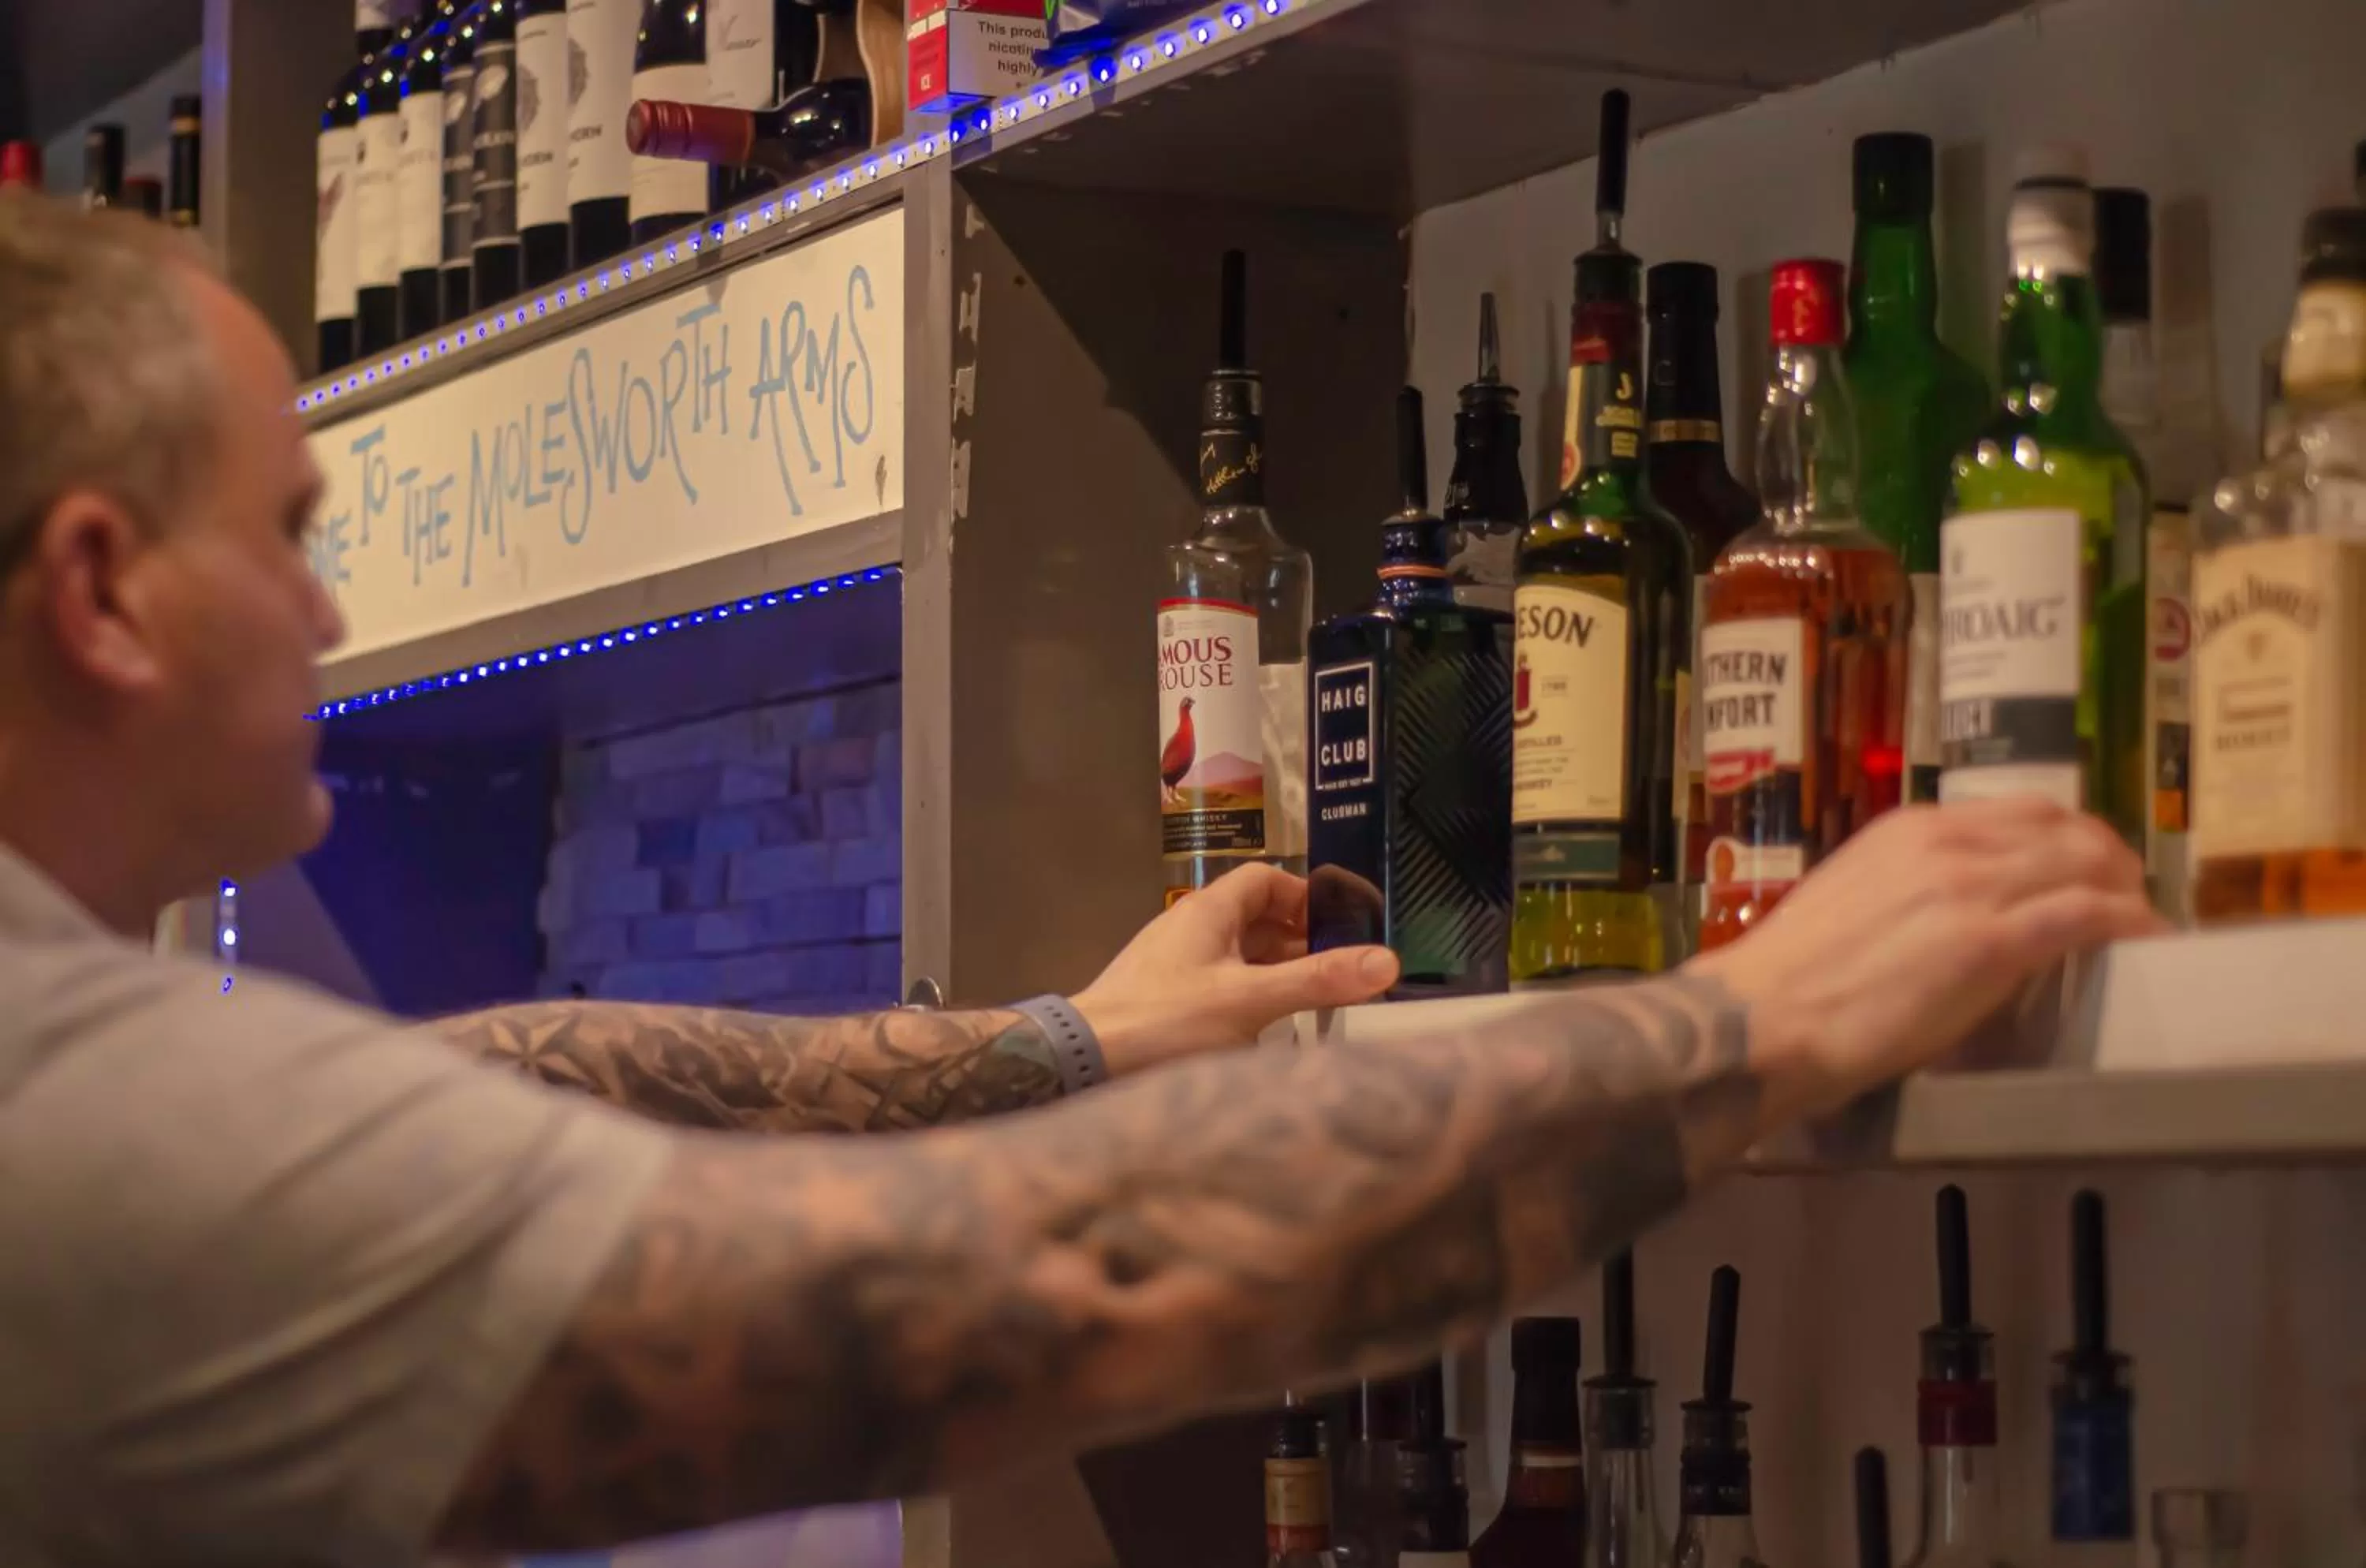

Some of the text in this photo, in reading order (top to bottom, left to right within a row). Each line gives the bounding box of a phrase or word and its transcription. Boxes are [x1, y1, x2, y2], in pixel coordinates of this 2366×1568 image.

[978, 21, 1006, 35] This
[350, 424, 388, 547] TO
[397, 467, 454, 587] THE
[462, 303, 732, 588] MOLESWORTH
[748, 264, 874, 516] ARMS
[1703, 651, 1788, 686] THERN
[1320, 685, 1367, 713] HAIG
[1320, 737, 1367, 767] CLUB
[1321, 801, 1368, 821] CLUBMAN
